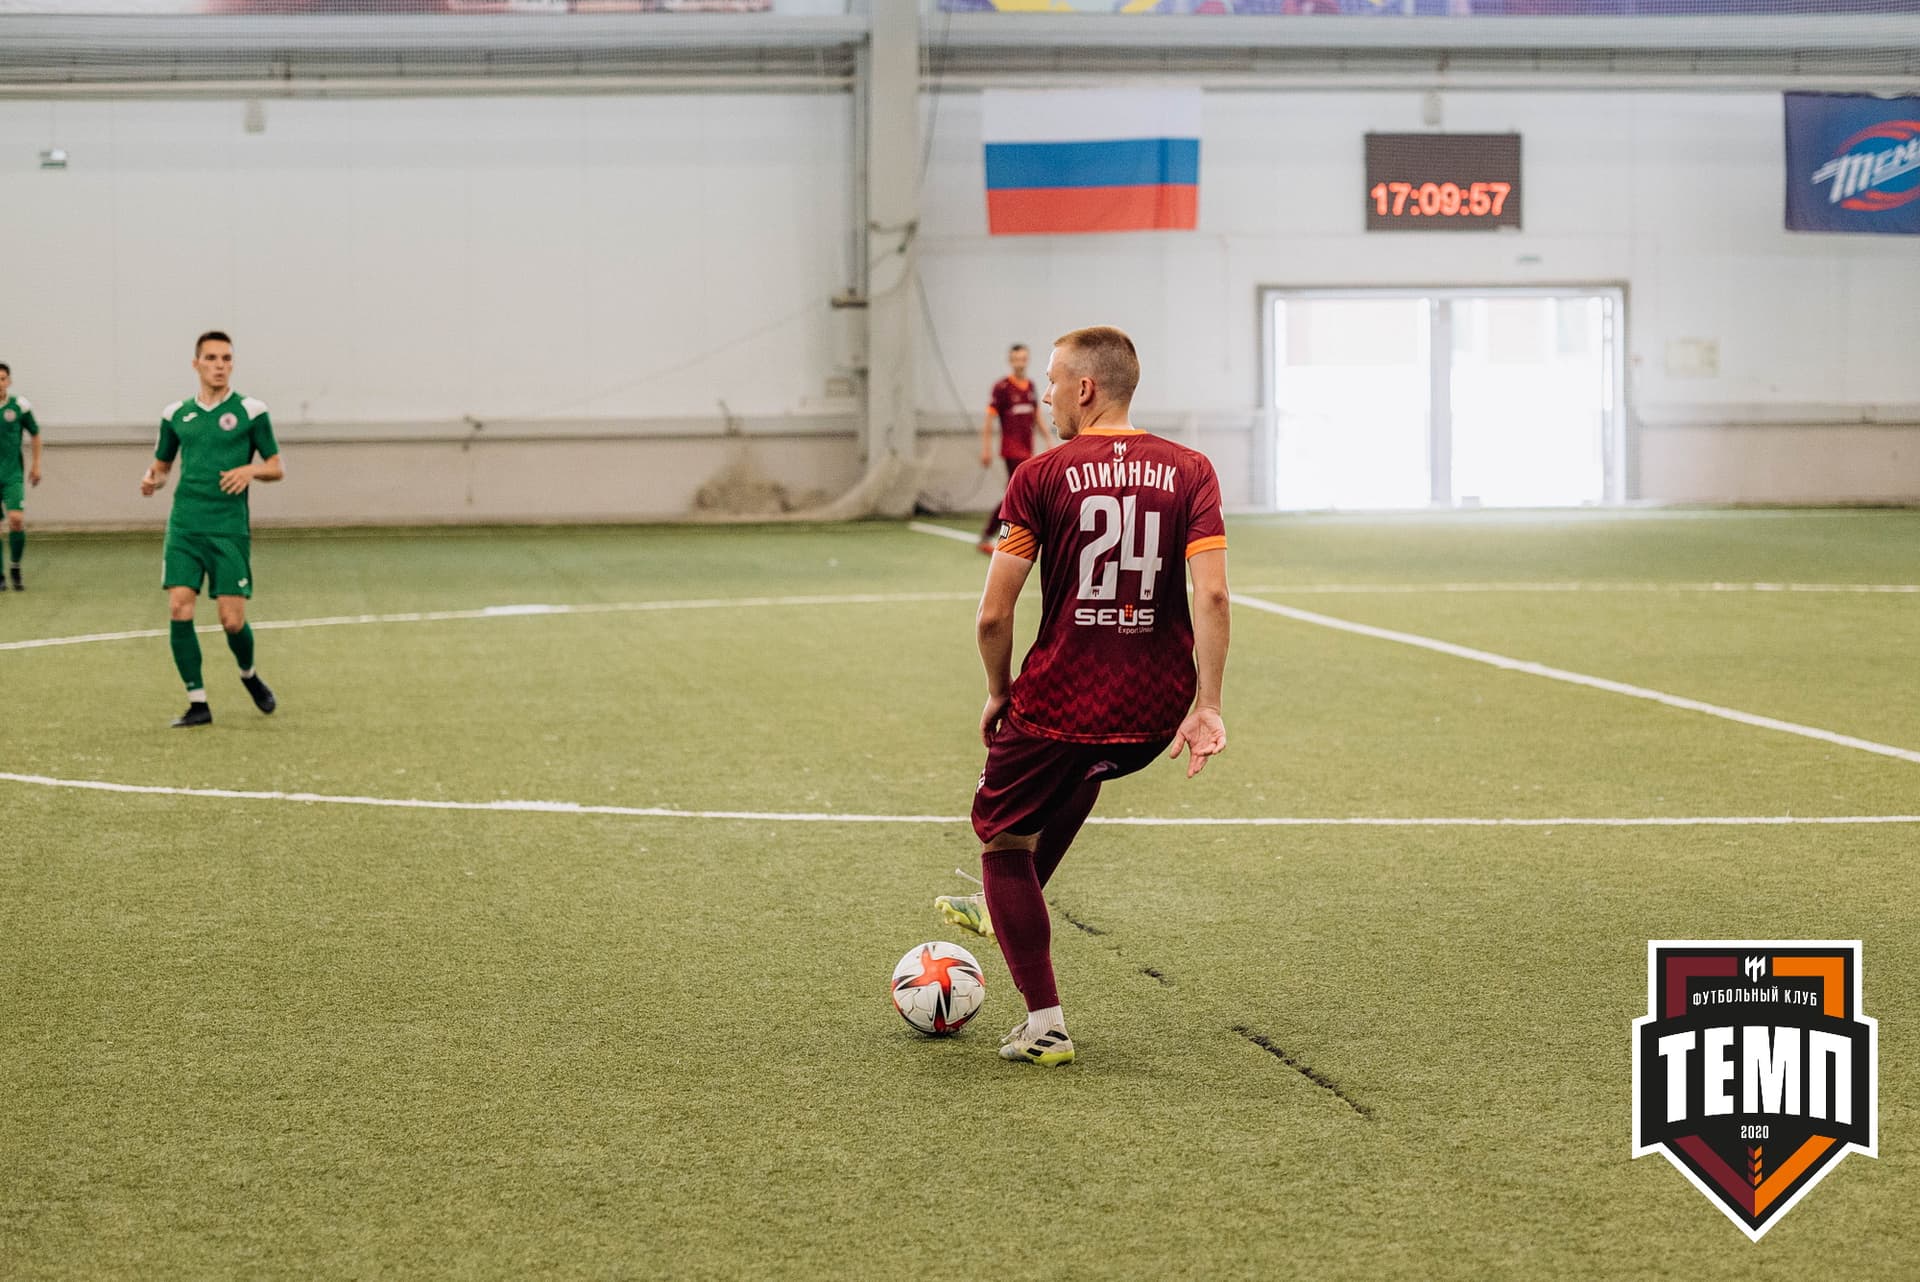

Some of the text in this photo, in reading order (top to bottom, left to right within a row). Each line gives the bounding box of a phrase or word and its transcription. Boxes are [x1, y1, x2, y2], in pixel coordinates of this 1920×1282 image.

[1371, 182, 1511, 216] 17:09:57
[1065, 456, 1176, 493] ОЛИЙНЫК
[1077, 495, 1163, 600] 24
